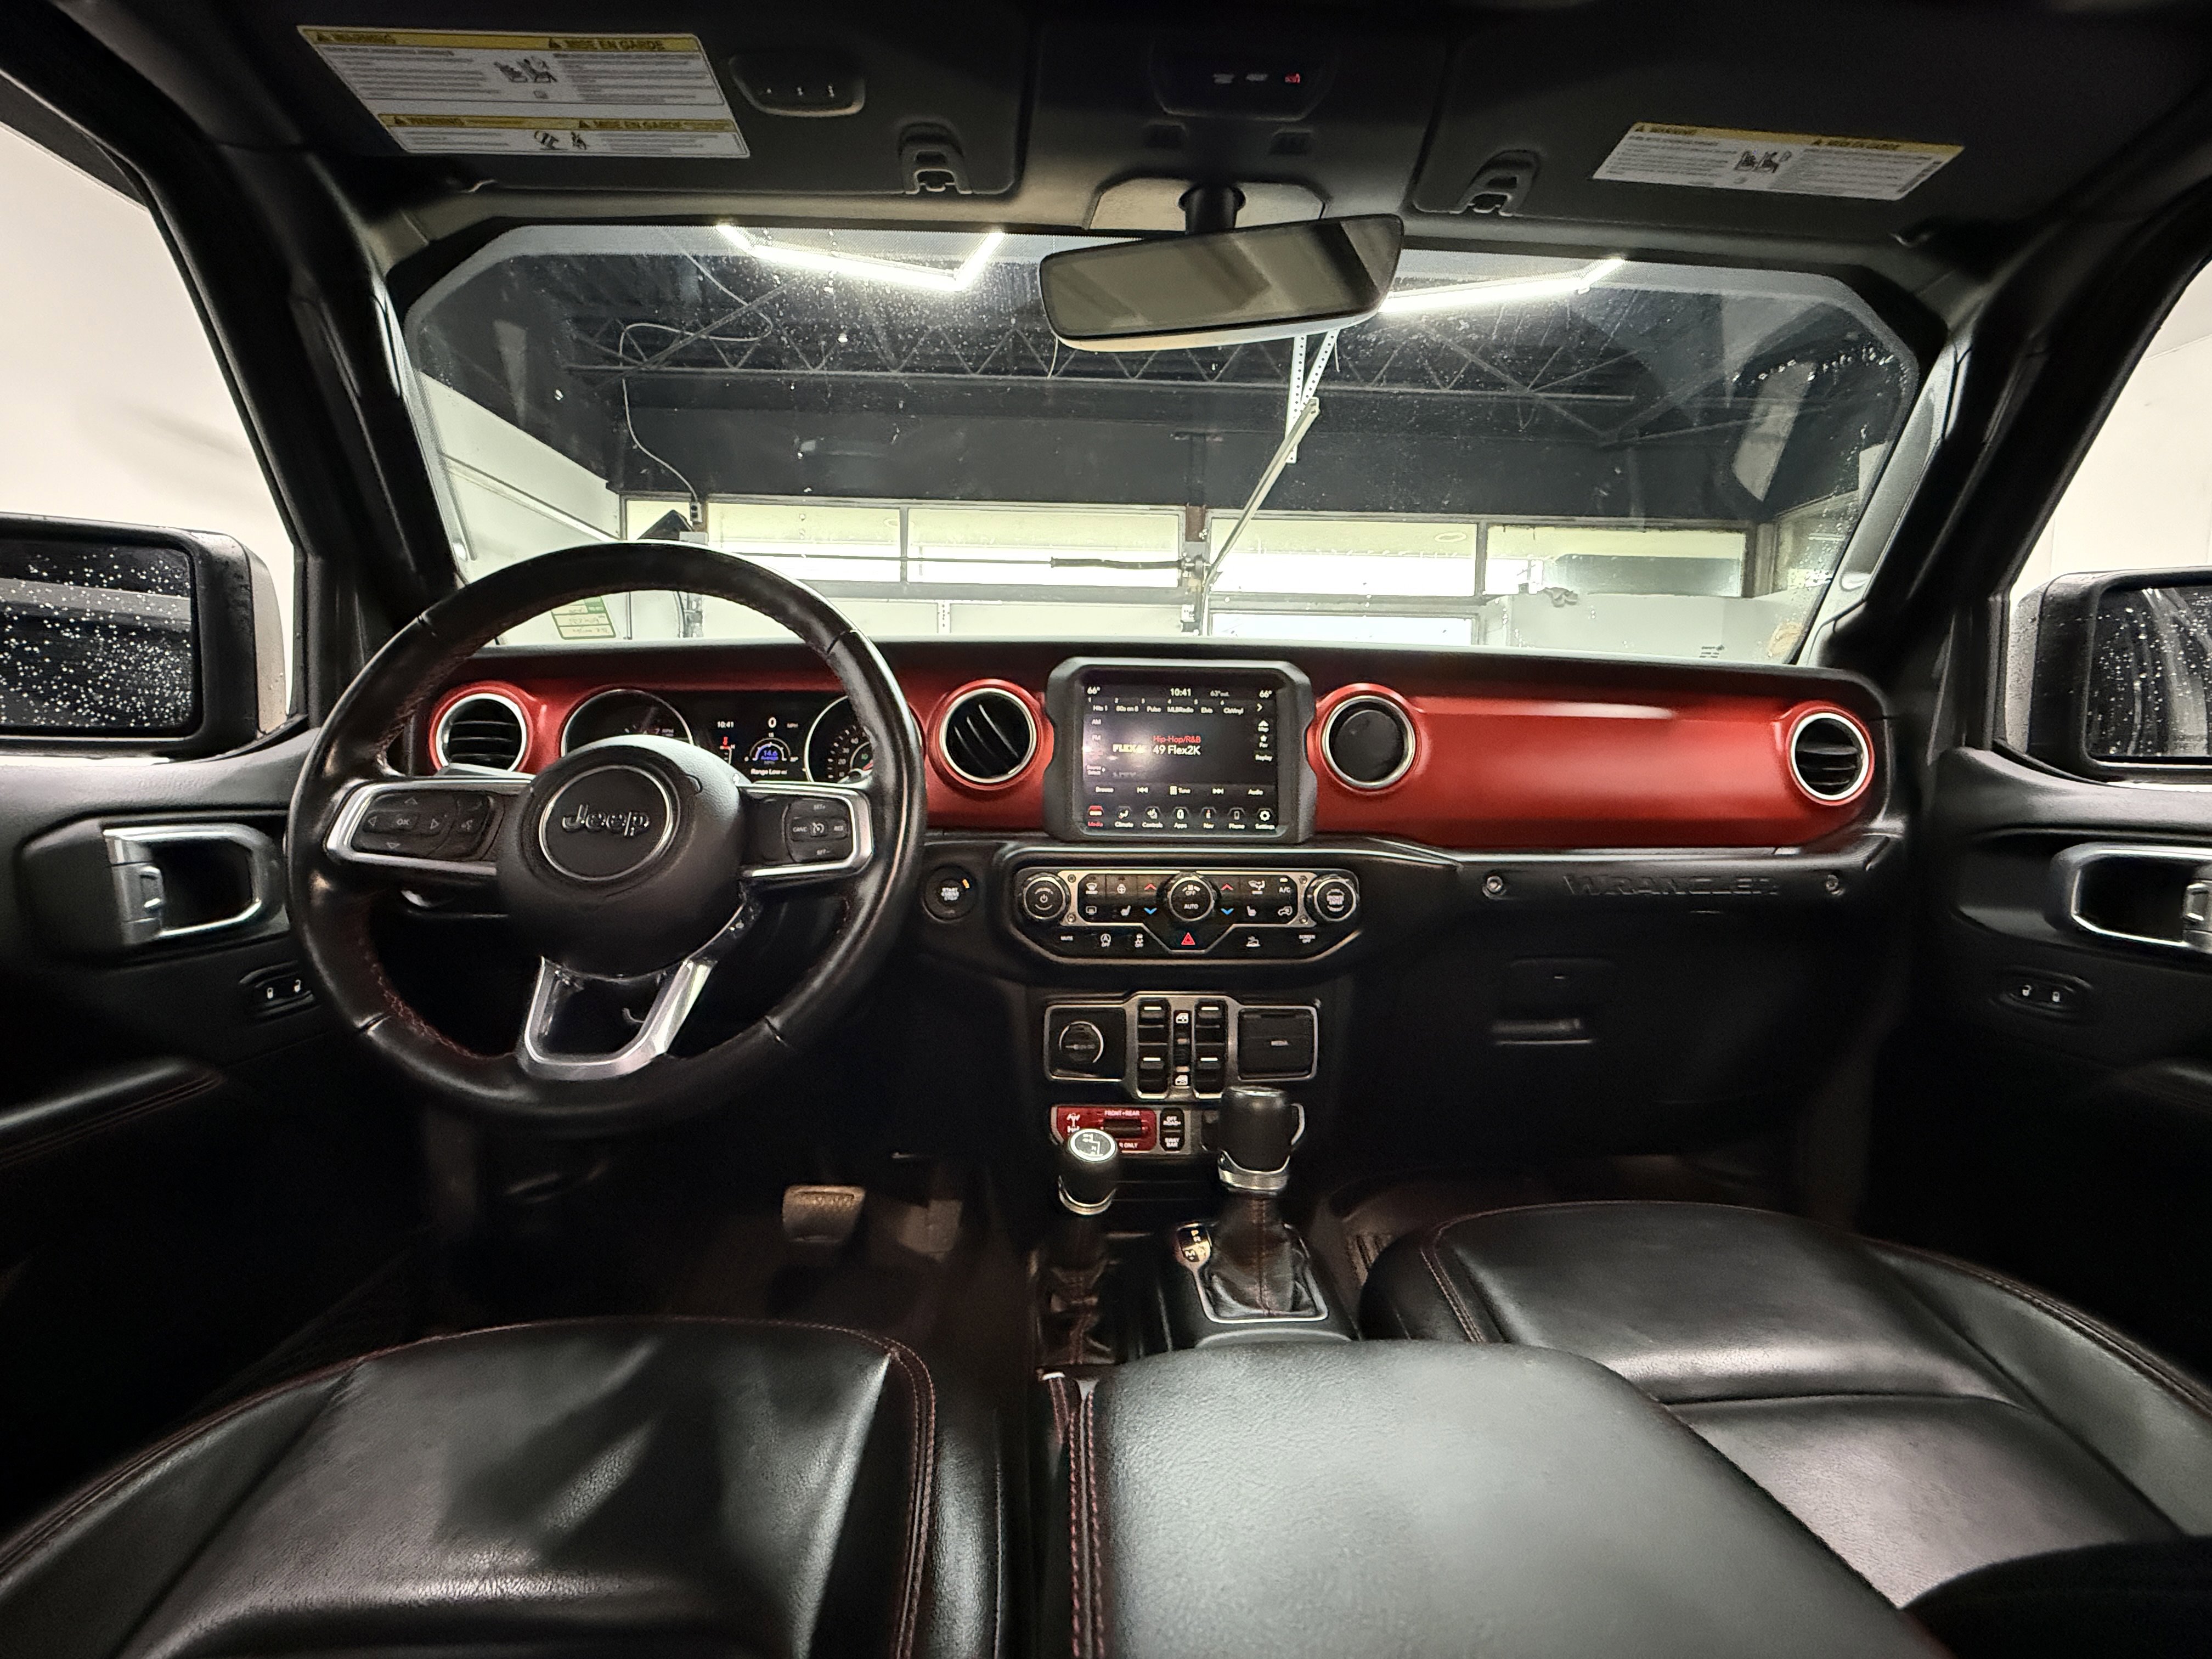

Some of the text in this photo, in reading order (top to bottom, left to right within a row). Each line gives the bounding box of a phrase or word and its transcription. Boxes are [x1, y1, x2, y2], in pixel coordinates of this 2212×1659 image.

[1087, 686, 1101, 695] 66°
[1170, 688, 1191, 696] 10:41
[1259, 690, 1272, 698] 66°
[768, 716, 777, 729] 0
[1153, 735, 1201, 744] Hip-Hop/R&B
[1153, 744, 1201, 755] 49 Flex2K
[561, 804, 651, 837] Jeep
[1562, 876, 1780, 896] WRANGLER
